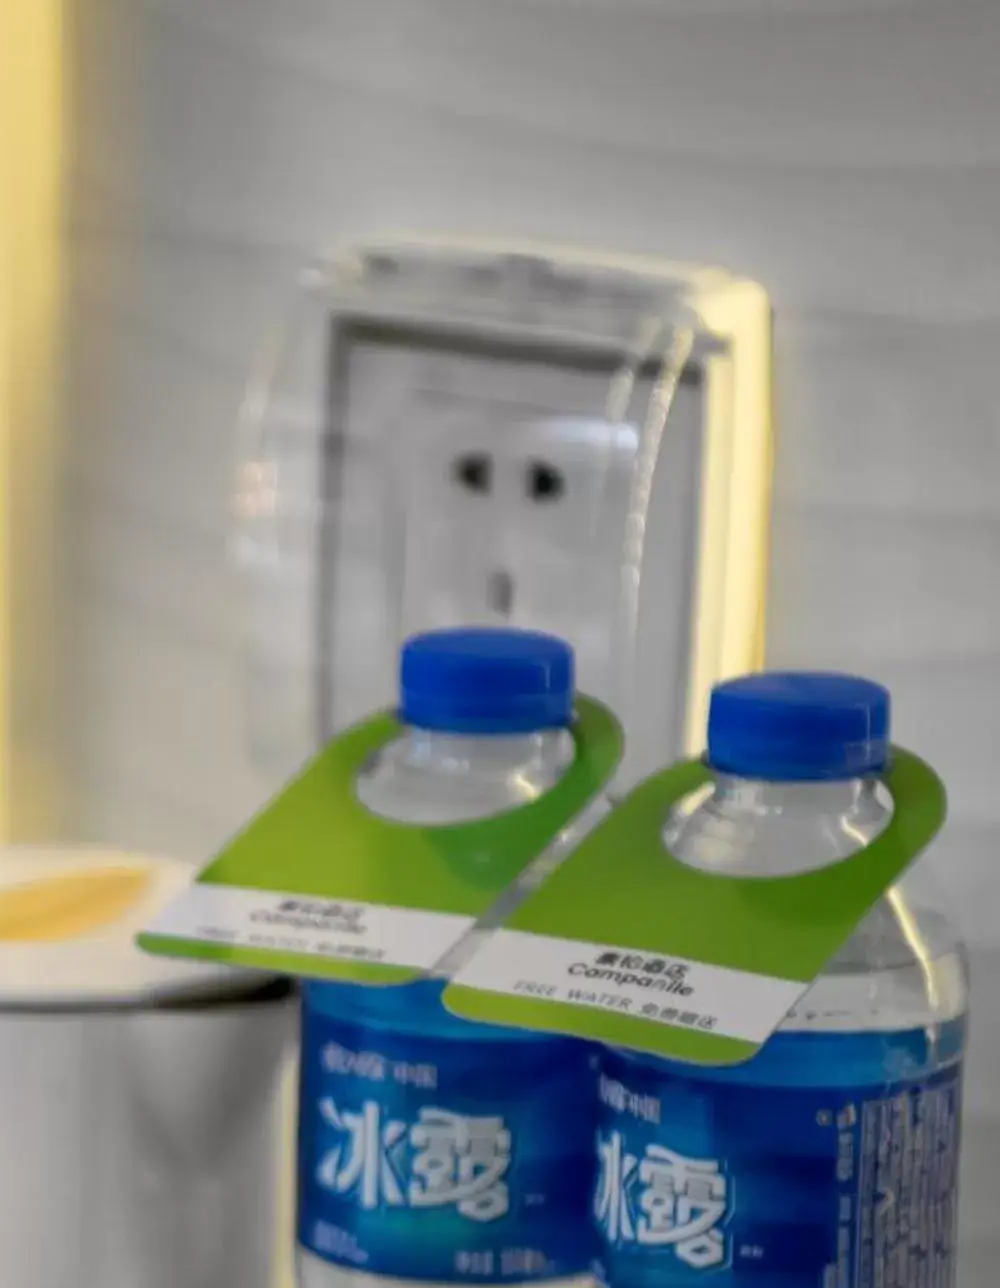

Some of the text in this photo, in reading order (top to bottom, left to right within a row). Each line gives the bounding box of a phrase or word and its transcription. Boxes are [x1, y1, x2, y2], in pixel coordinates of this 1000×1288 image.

[513, 979, 558, 996] FREE
[567, 988, 633, 1010] WATER
[567, 962, 696, 997] Campanile
[316, 1096, 513, 1222] 冰露
